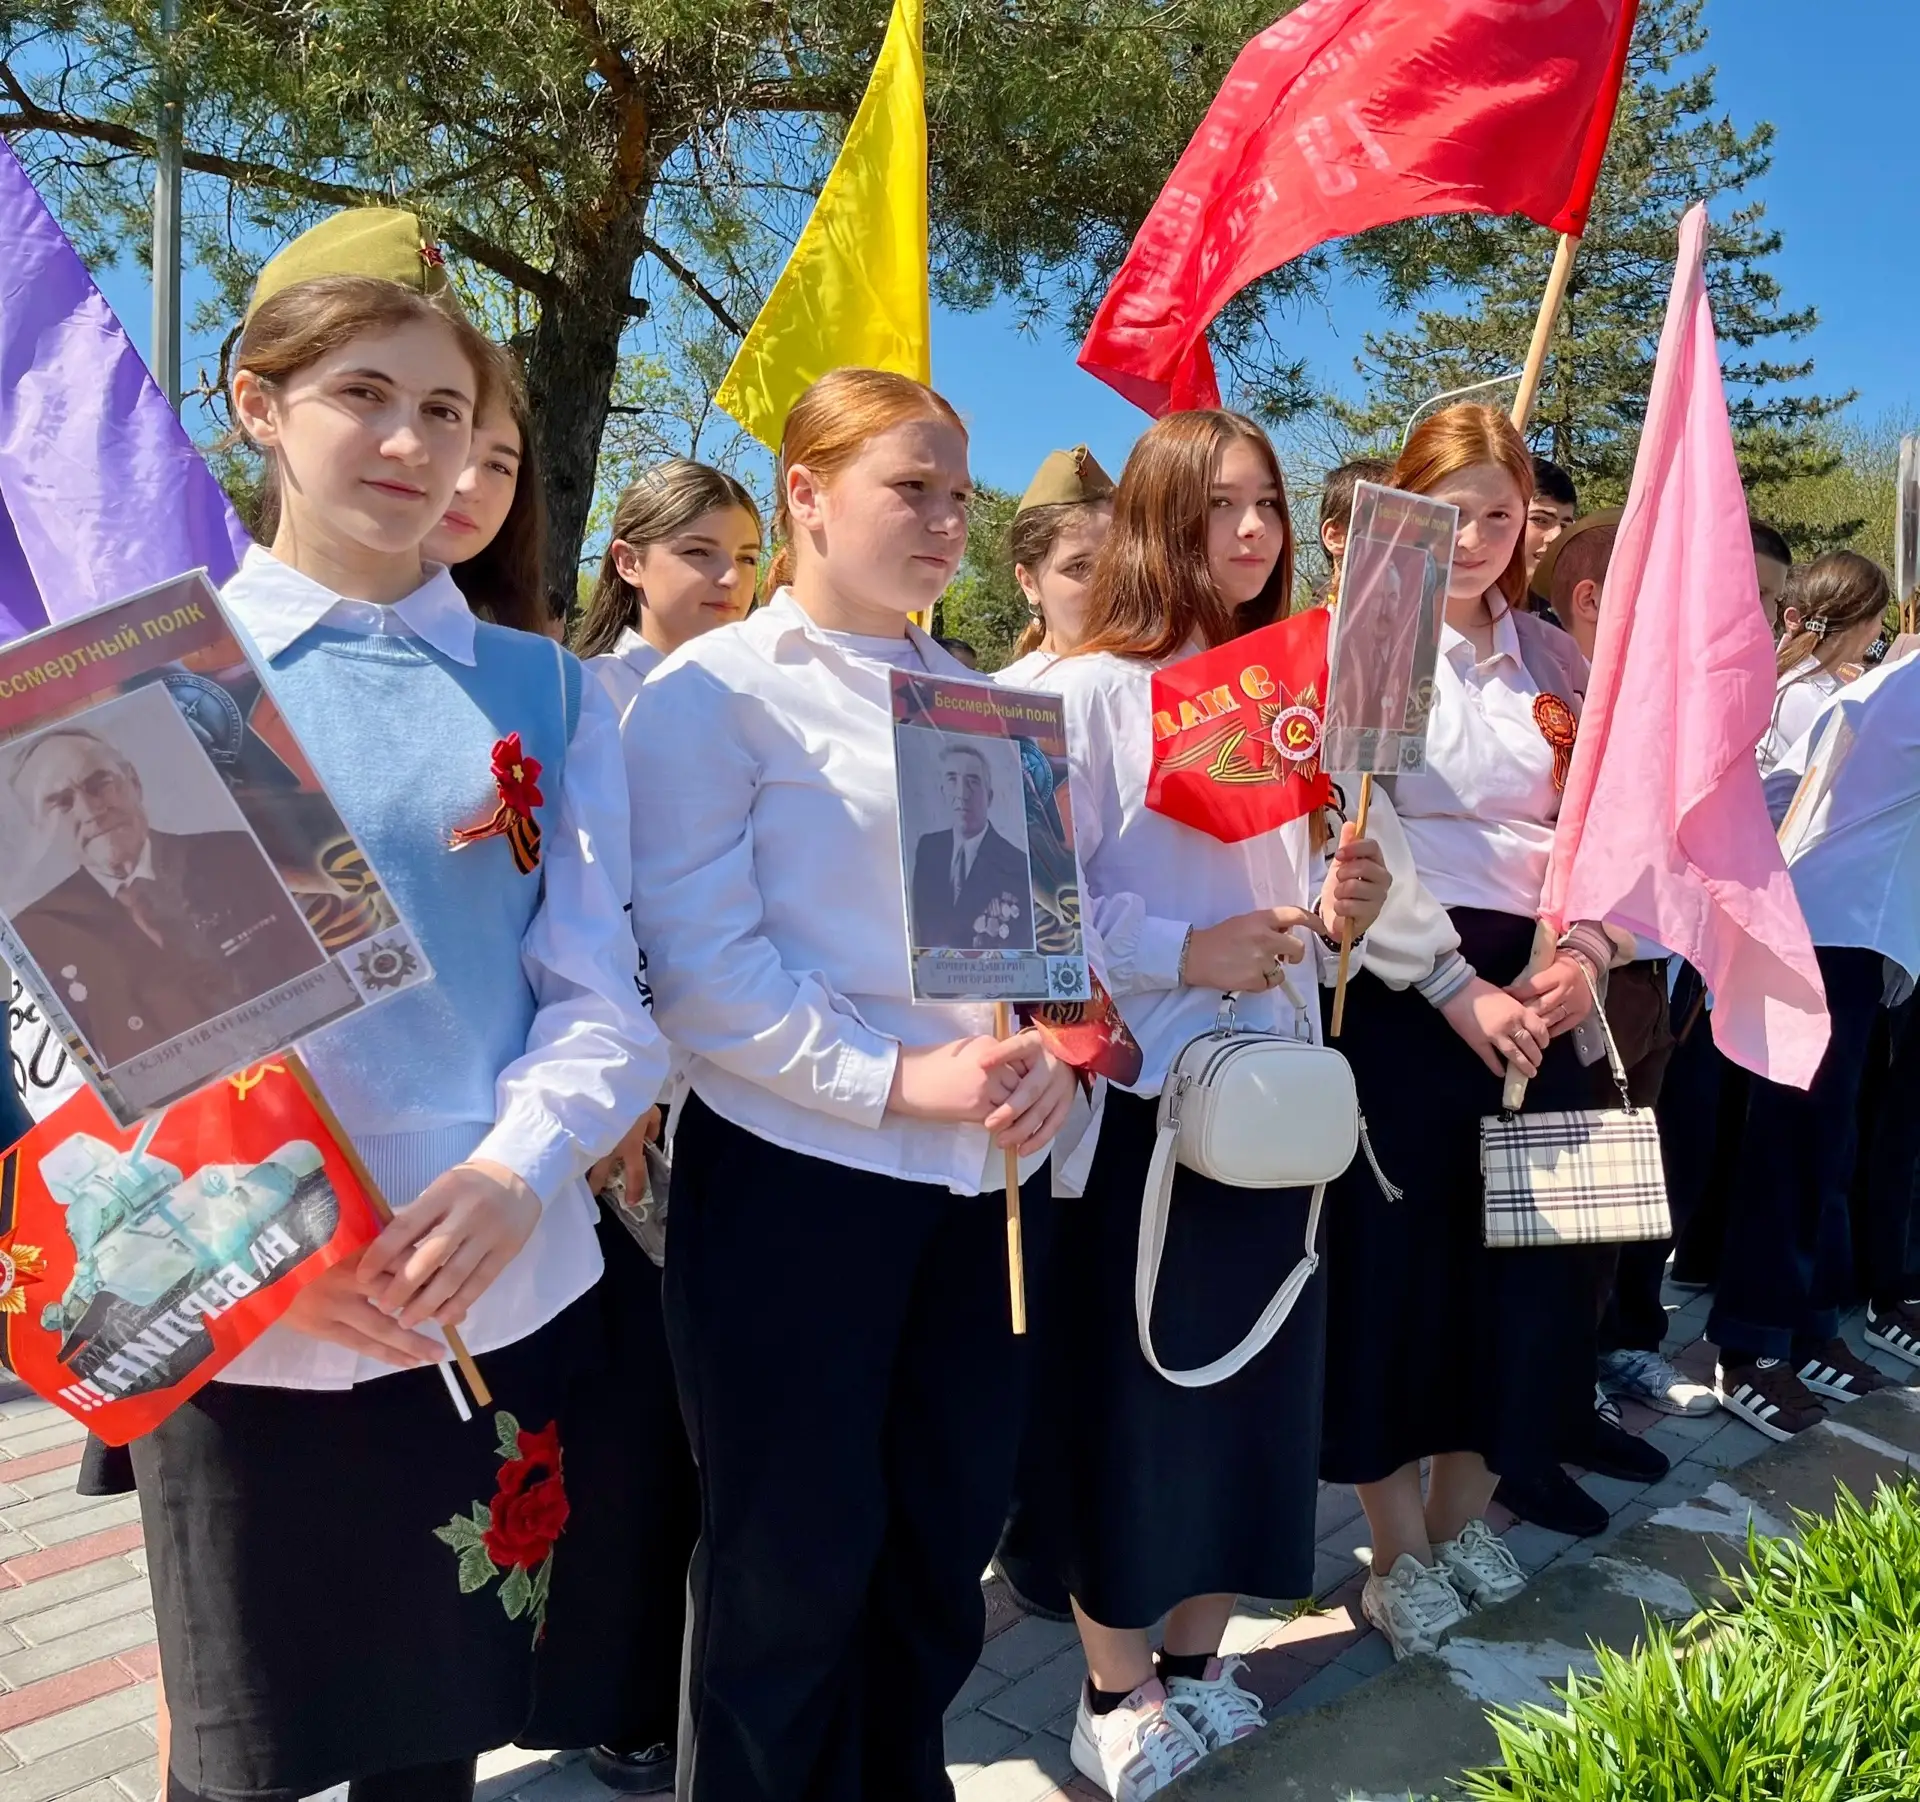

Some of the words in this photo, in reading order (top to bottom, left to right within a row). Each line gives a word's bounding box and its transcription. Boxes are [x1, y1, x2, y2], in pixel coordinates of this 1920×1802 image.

[141, 602, 206, 640] полк
[934, 690, 1024, 719] Бессмертный
[1026, 707, 1058, 723] полк
